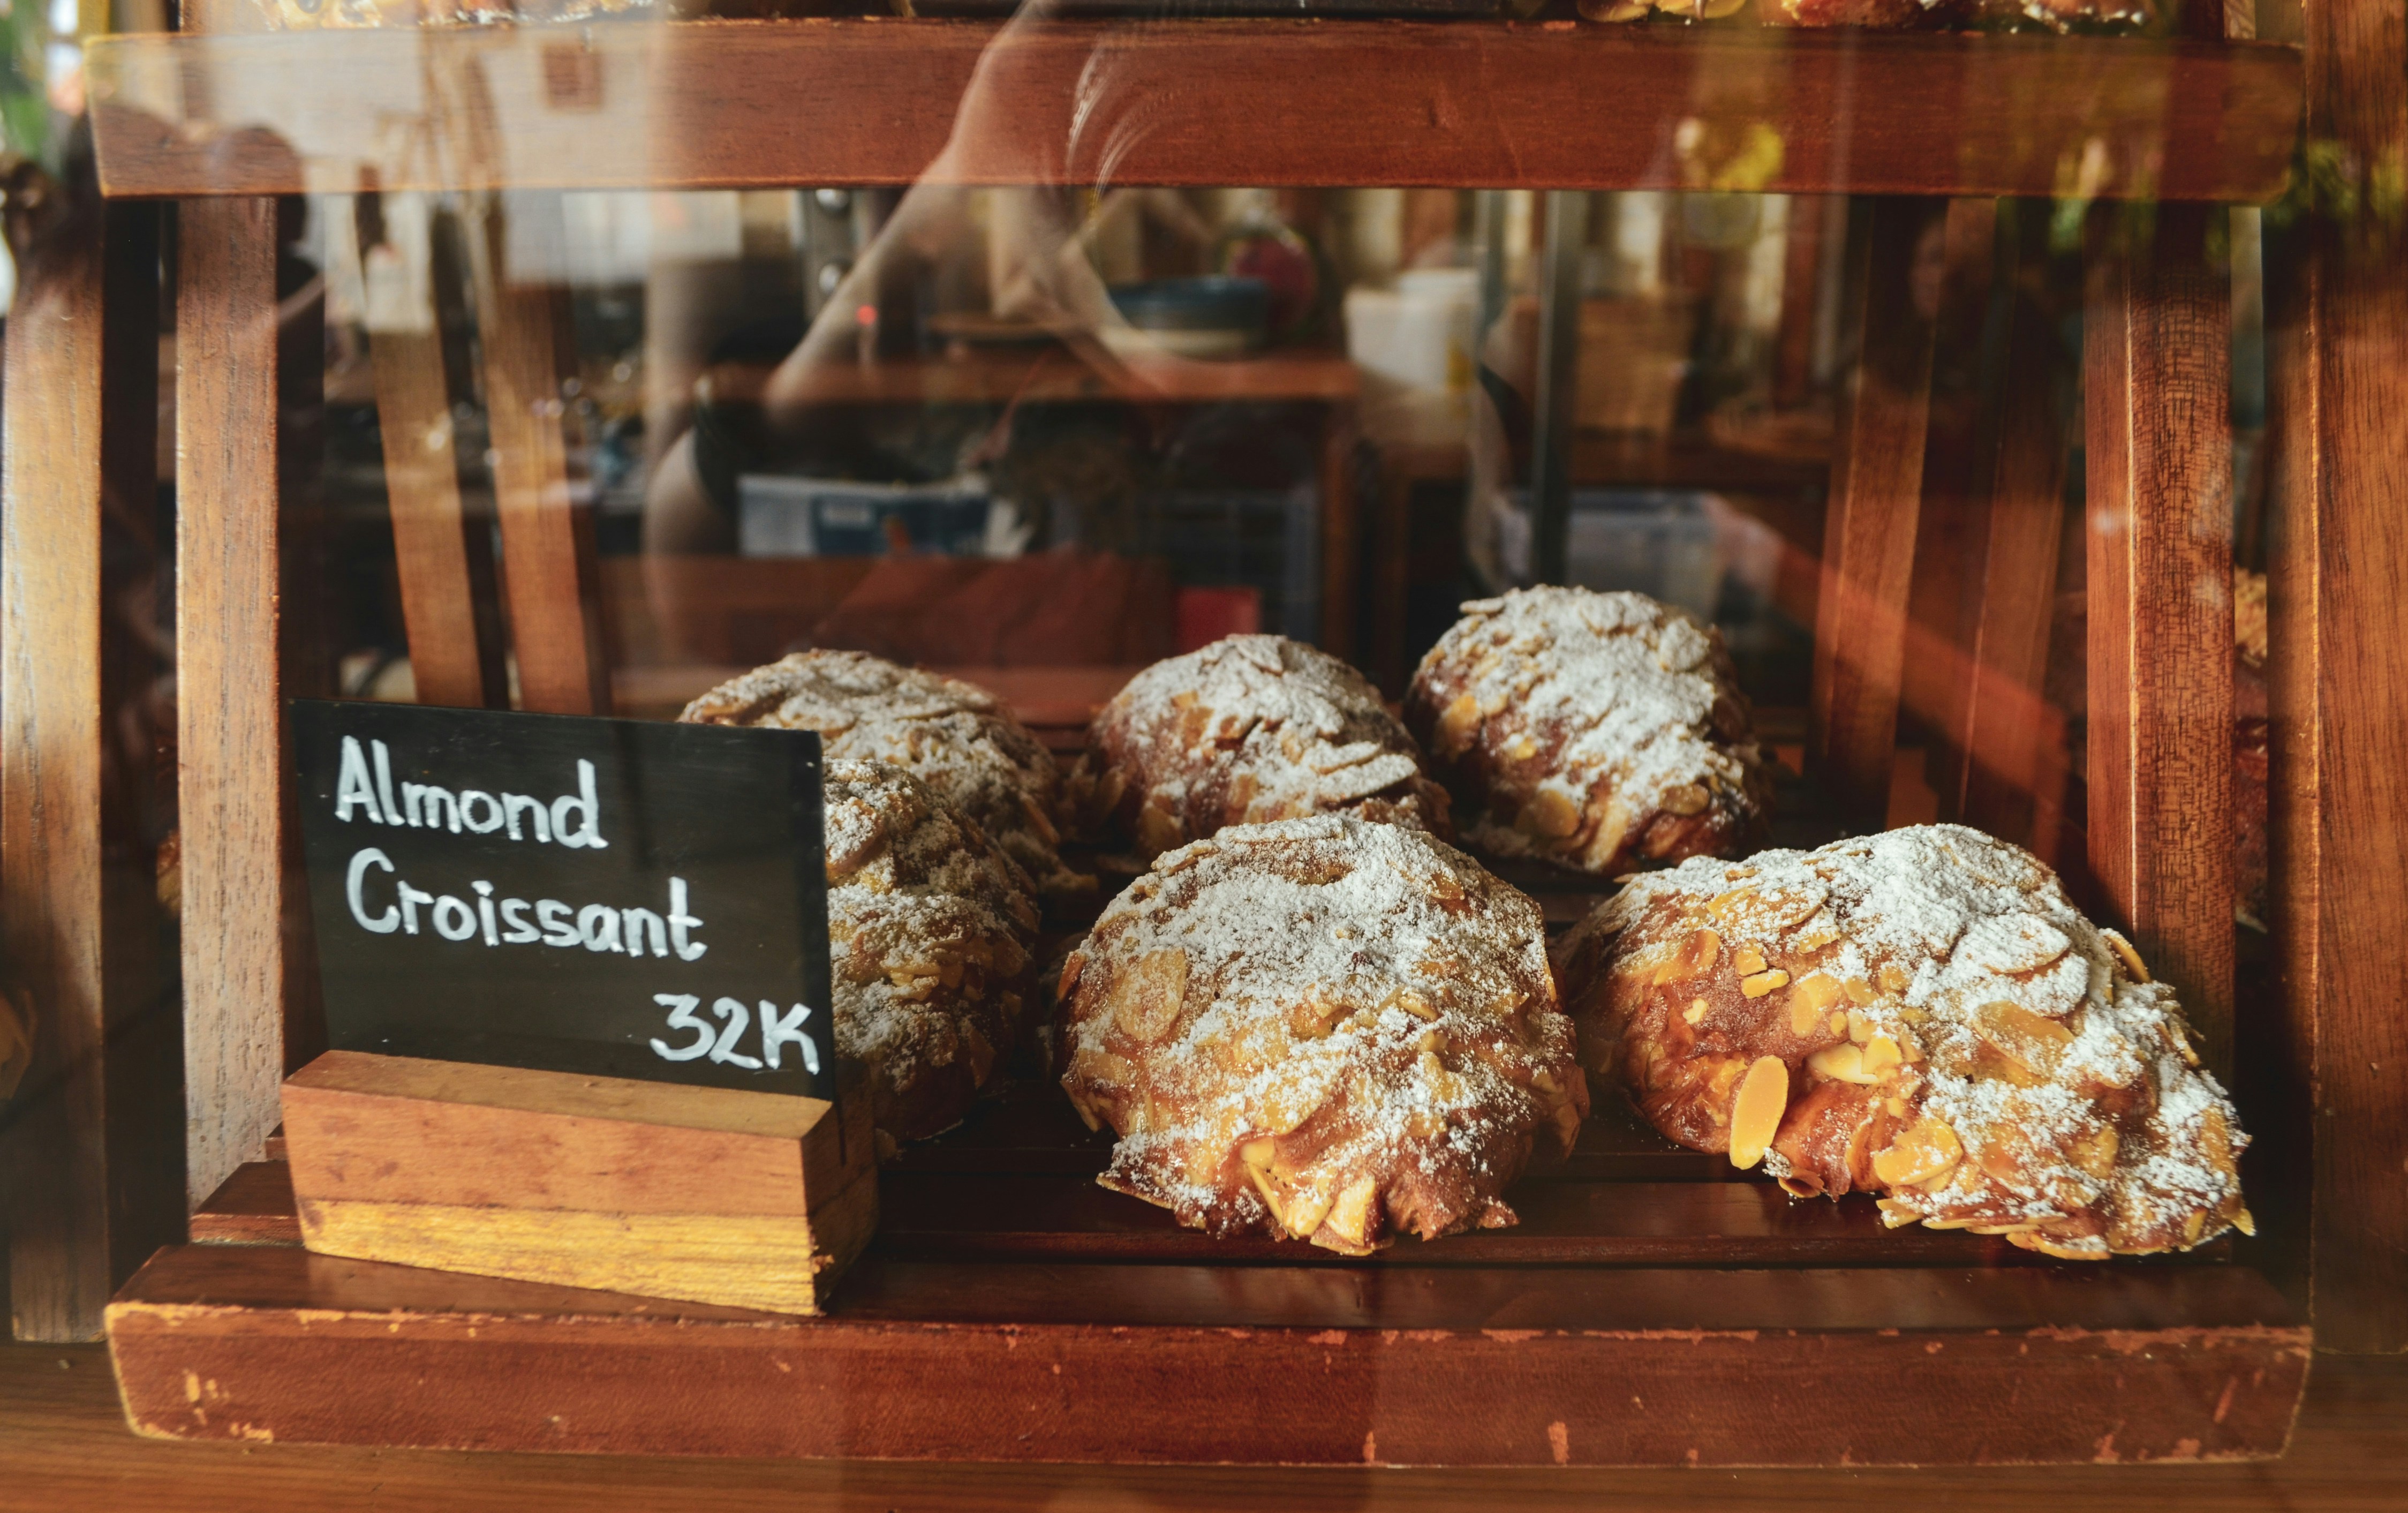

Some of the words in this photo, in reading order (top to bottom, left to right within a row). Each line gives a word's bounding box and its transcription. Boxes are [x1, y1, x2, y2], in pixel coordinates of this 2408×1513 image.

[334, 735, 609, 849] Almond
[346, 847, 708, 962] Croissant
[649, 993, 820, 1075] 32K
